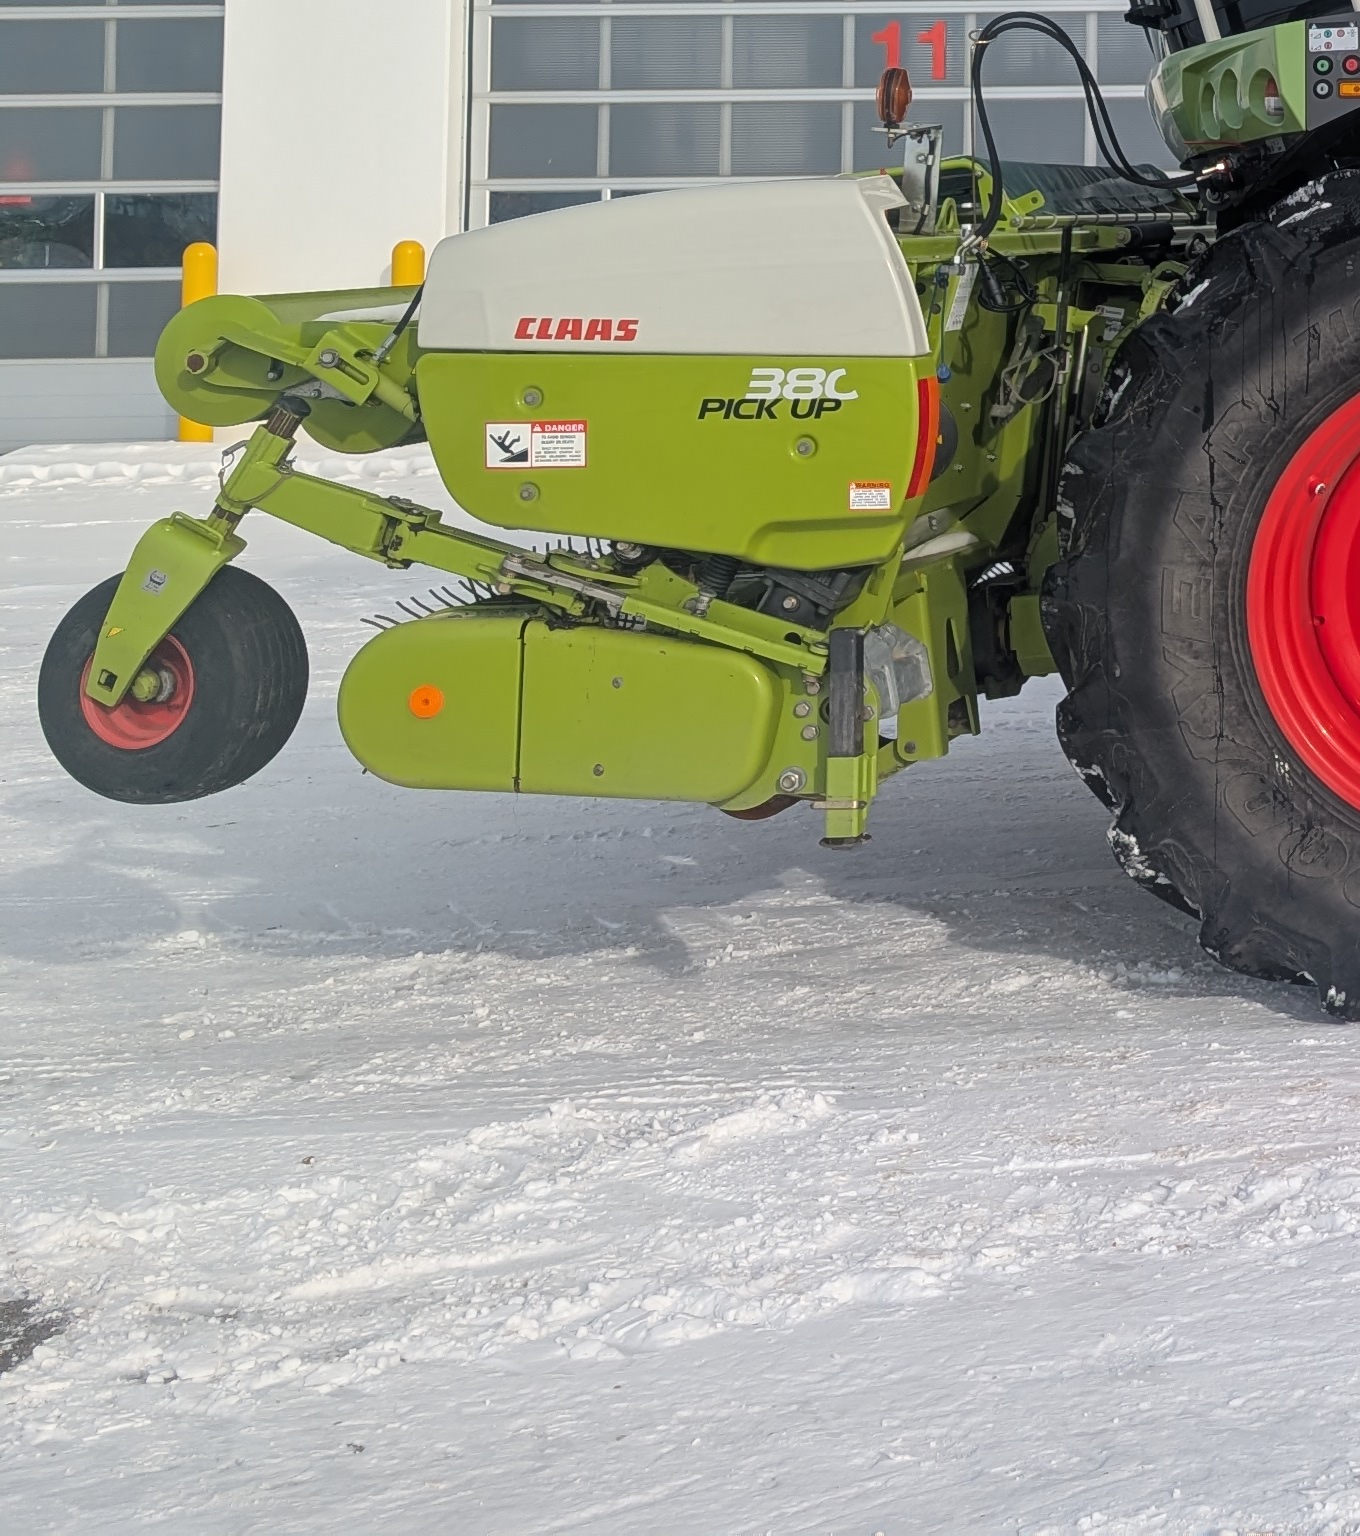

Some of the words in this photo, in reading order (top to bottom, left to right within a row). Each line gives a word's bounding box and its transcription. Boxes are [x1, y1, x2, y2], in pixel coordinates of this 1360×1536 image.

[871, 20, 947, 80] 11
[514, 317, 639, 342] CLAAS
[698, 398, 783, 420] PICK
[791, 398, 842, 420] UP
[544, 424, 585, 432] DANGER
